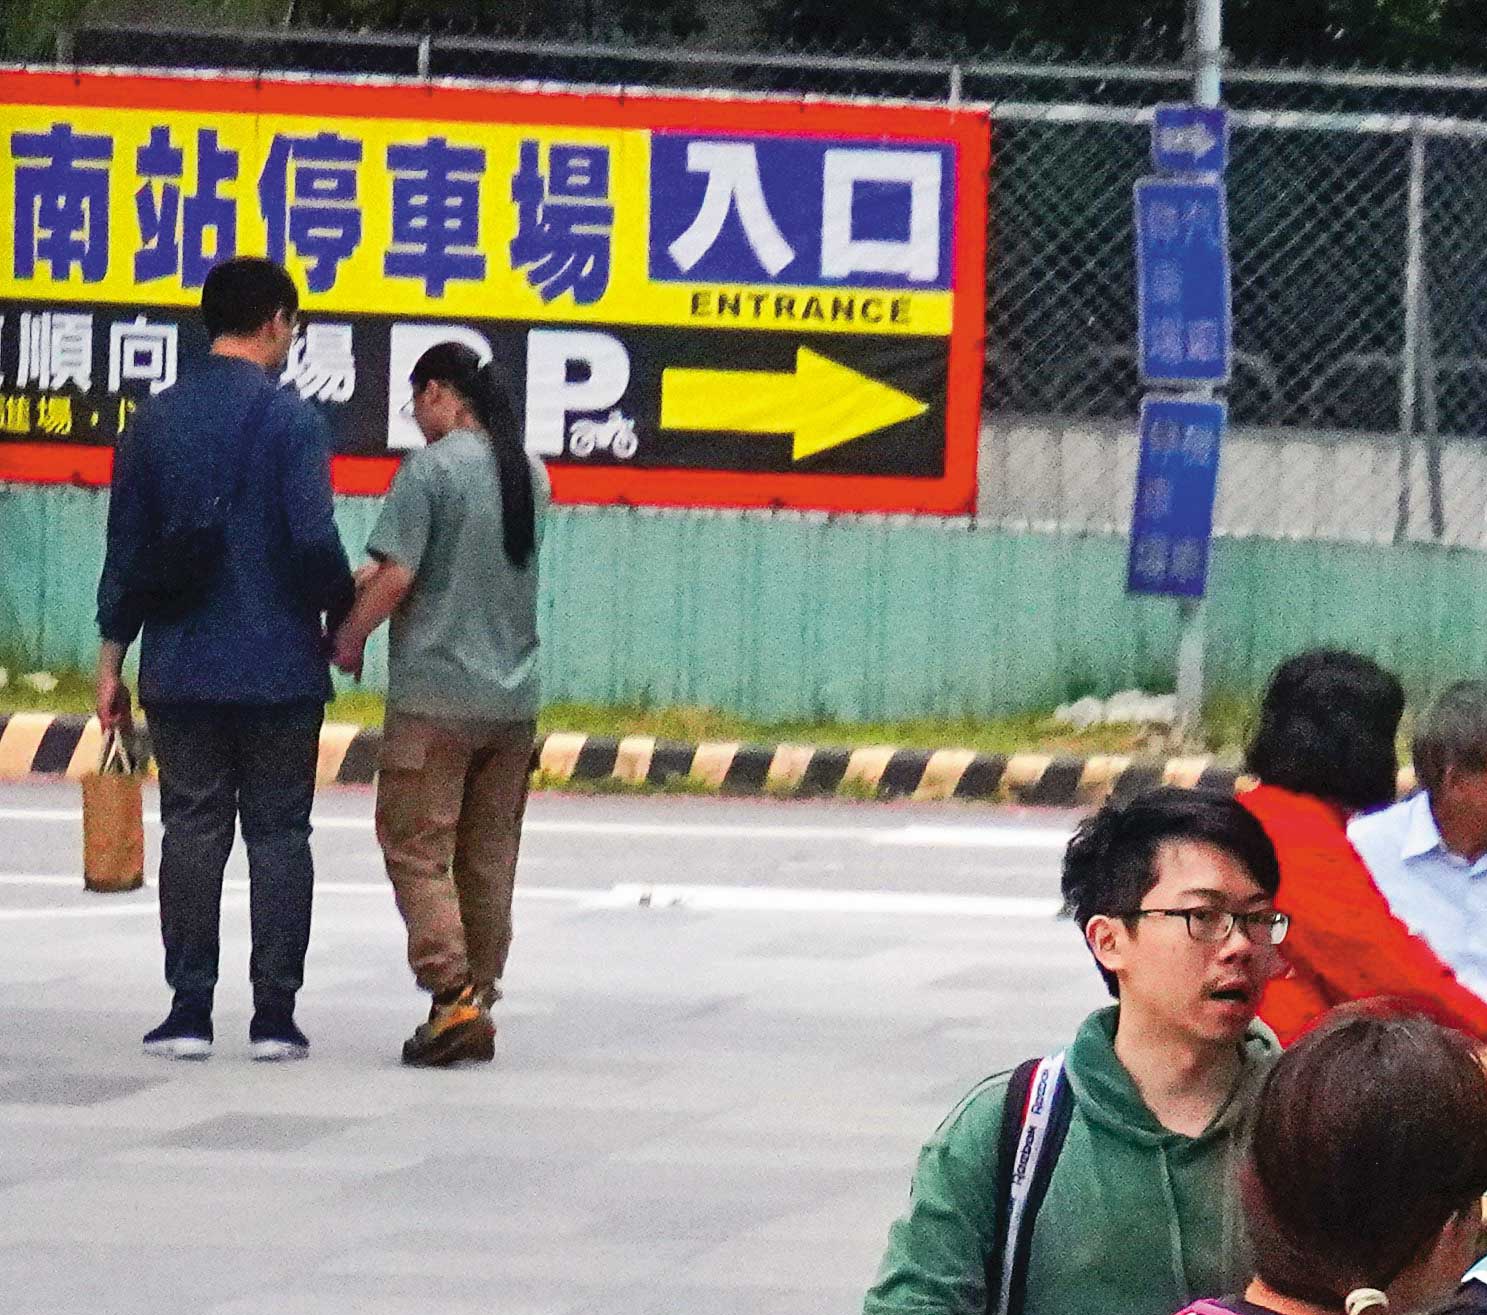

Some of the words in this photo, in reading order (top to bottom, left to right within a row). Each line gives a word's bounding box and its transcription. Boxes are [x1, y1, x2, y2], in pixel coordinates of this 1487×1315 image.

[10, 122, 614, 307] 南站停車場
[667, 140, 942, 282] 入口
[690, 289, 913, 324] ENTRANCE
[525, 328, 631, 457] P
